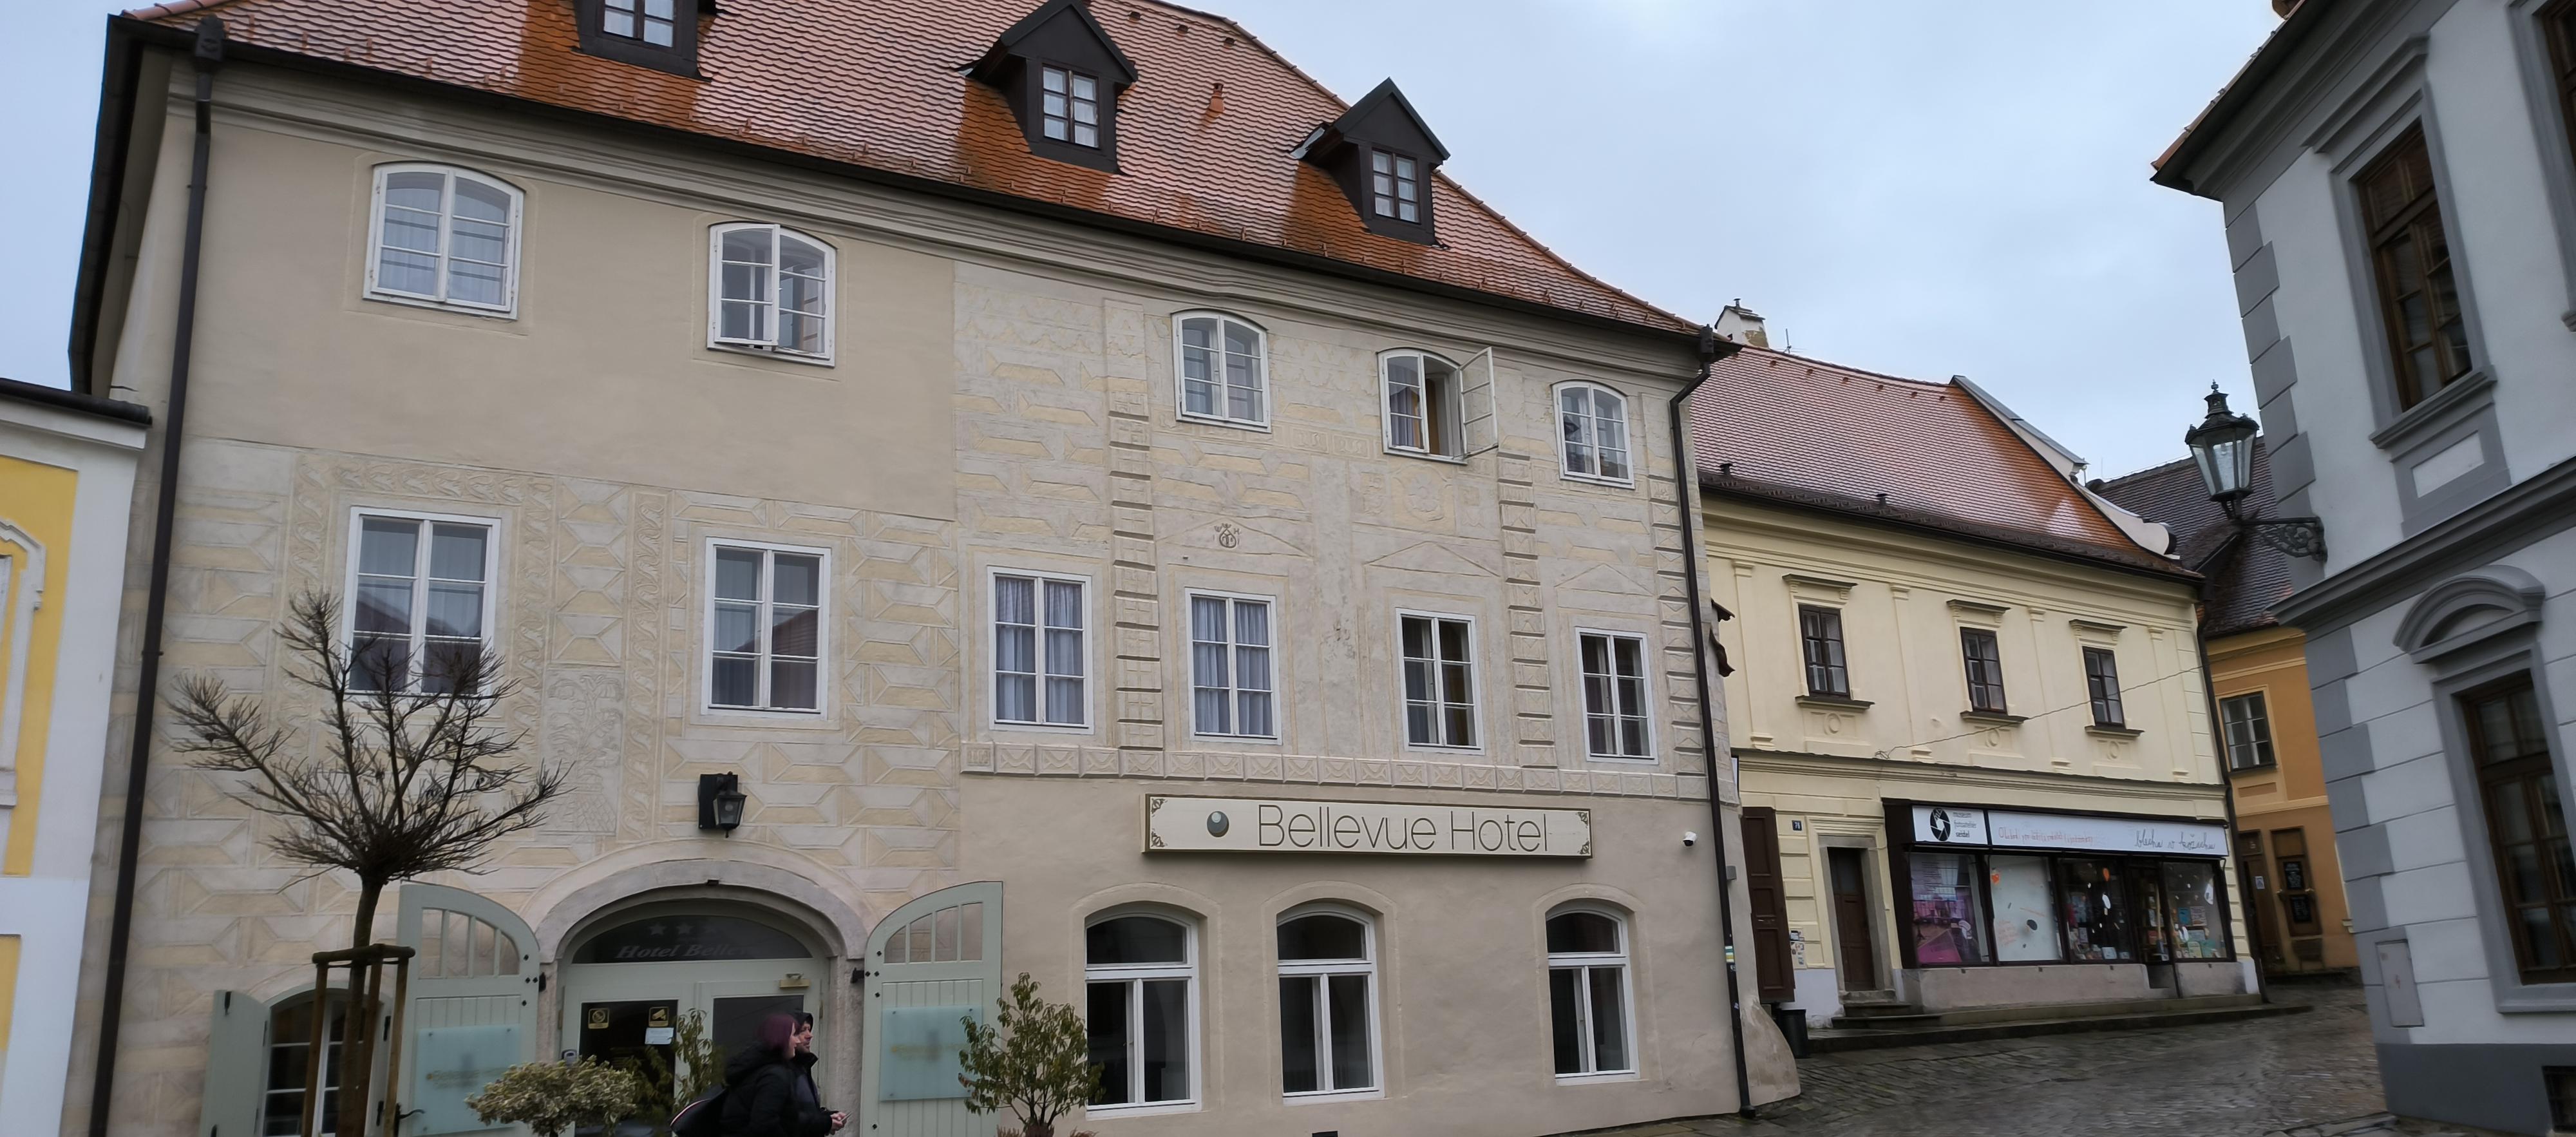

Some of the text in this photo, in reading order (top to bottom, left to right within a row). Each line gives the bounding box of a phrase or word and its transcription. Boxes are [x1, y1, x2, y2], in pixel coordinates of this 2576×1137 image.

[1259, 804, 1548, 852] Bellevue Hotel
[615, 943, 762, 959] Hotel Bellev
